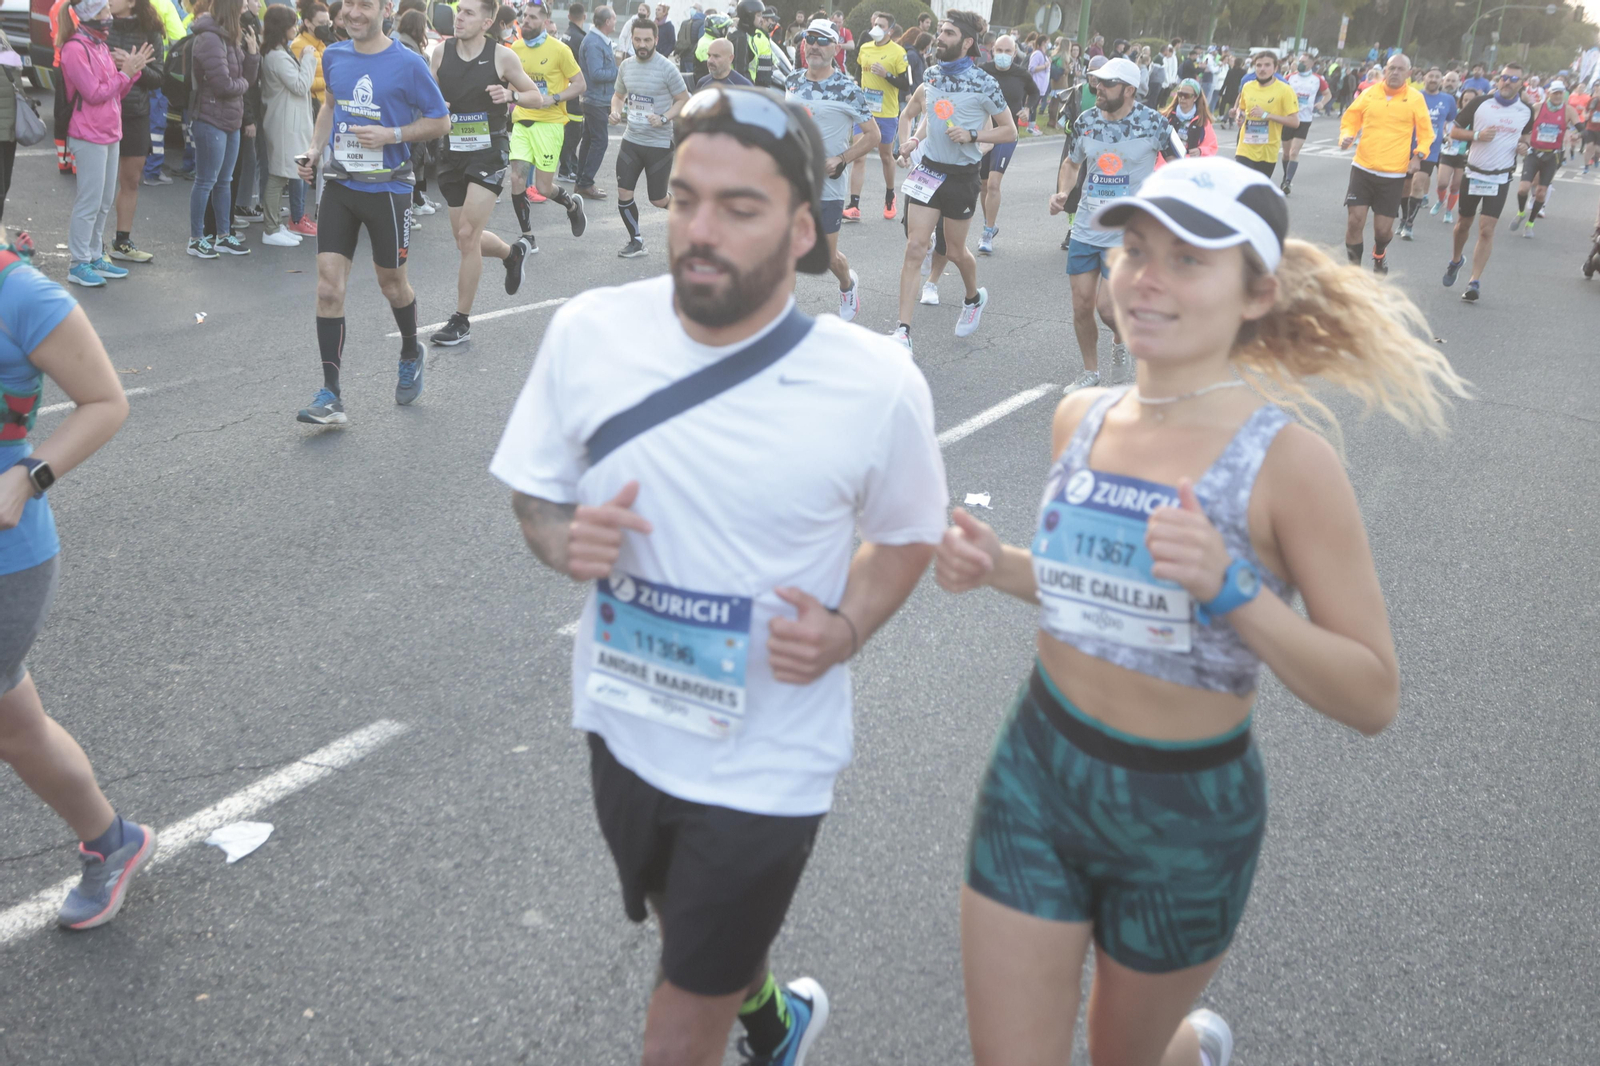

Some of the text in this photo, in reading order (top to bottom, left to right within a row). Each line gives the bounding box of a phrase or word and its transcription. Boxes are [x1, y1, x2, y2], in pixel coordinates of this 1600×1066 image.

[348, 106, 381, 117] MARATHON
[346, 140, 364, 149] 844
[1075, 533, 1138, 567] 11367
[638, 585, 730, 624] ZURICH
[1039, 565, 1169, 613] LUCIE CALLEJA
[653, 671, 738, 708] MARQUES
